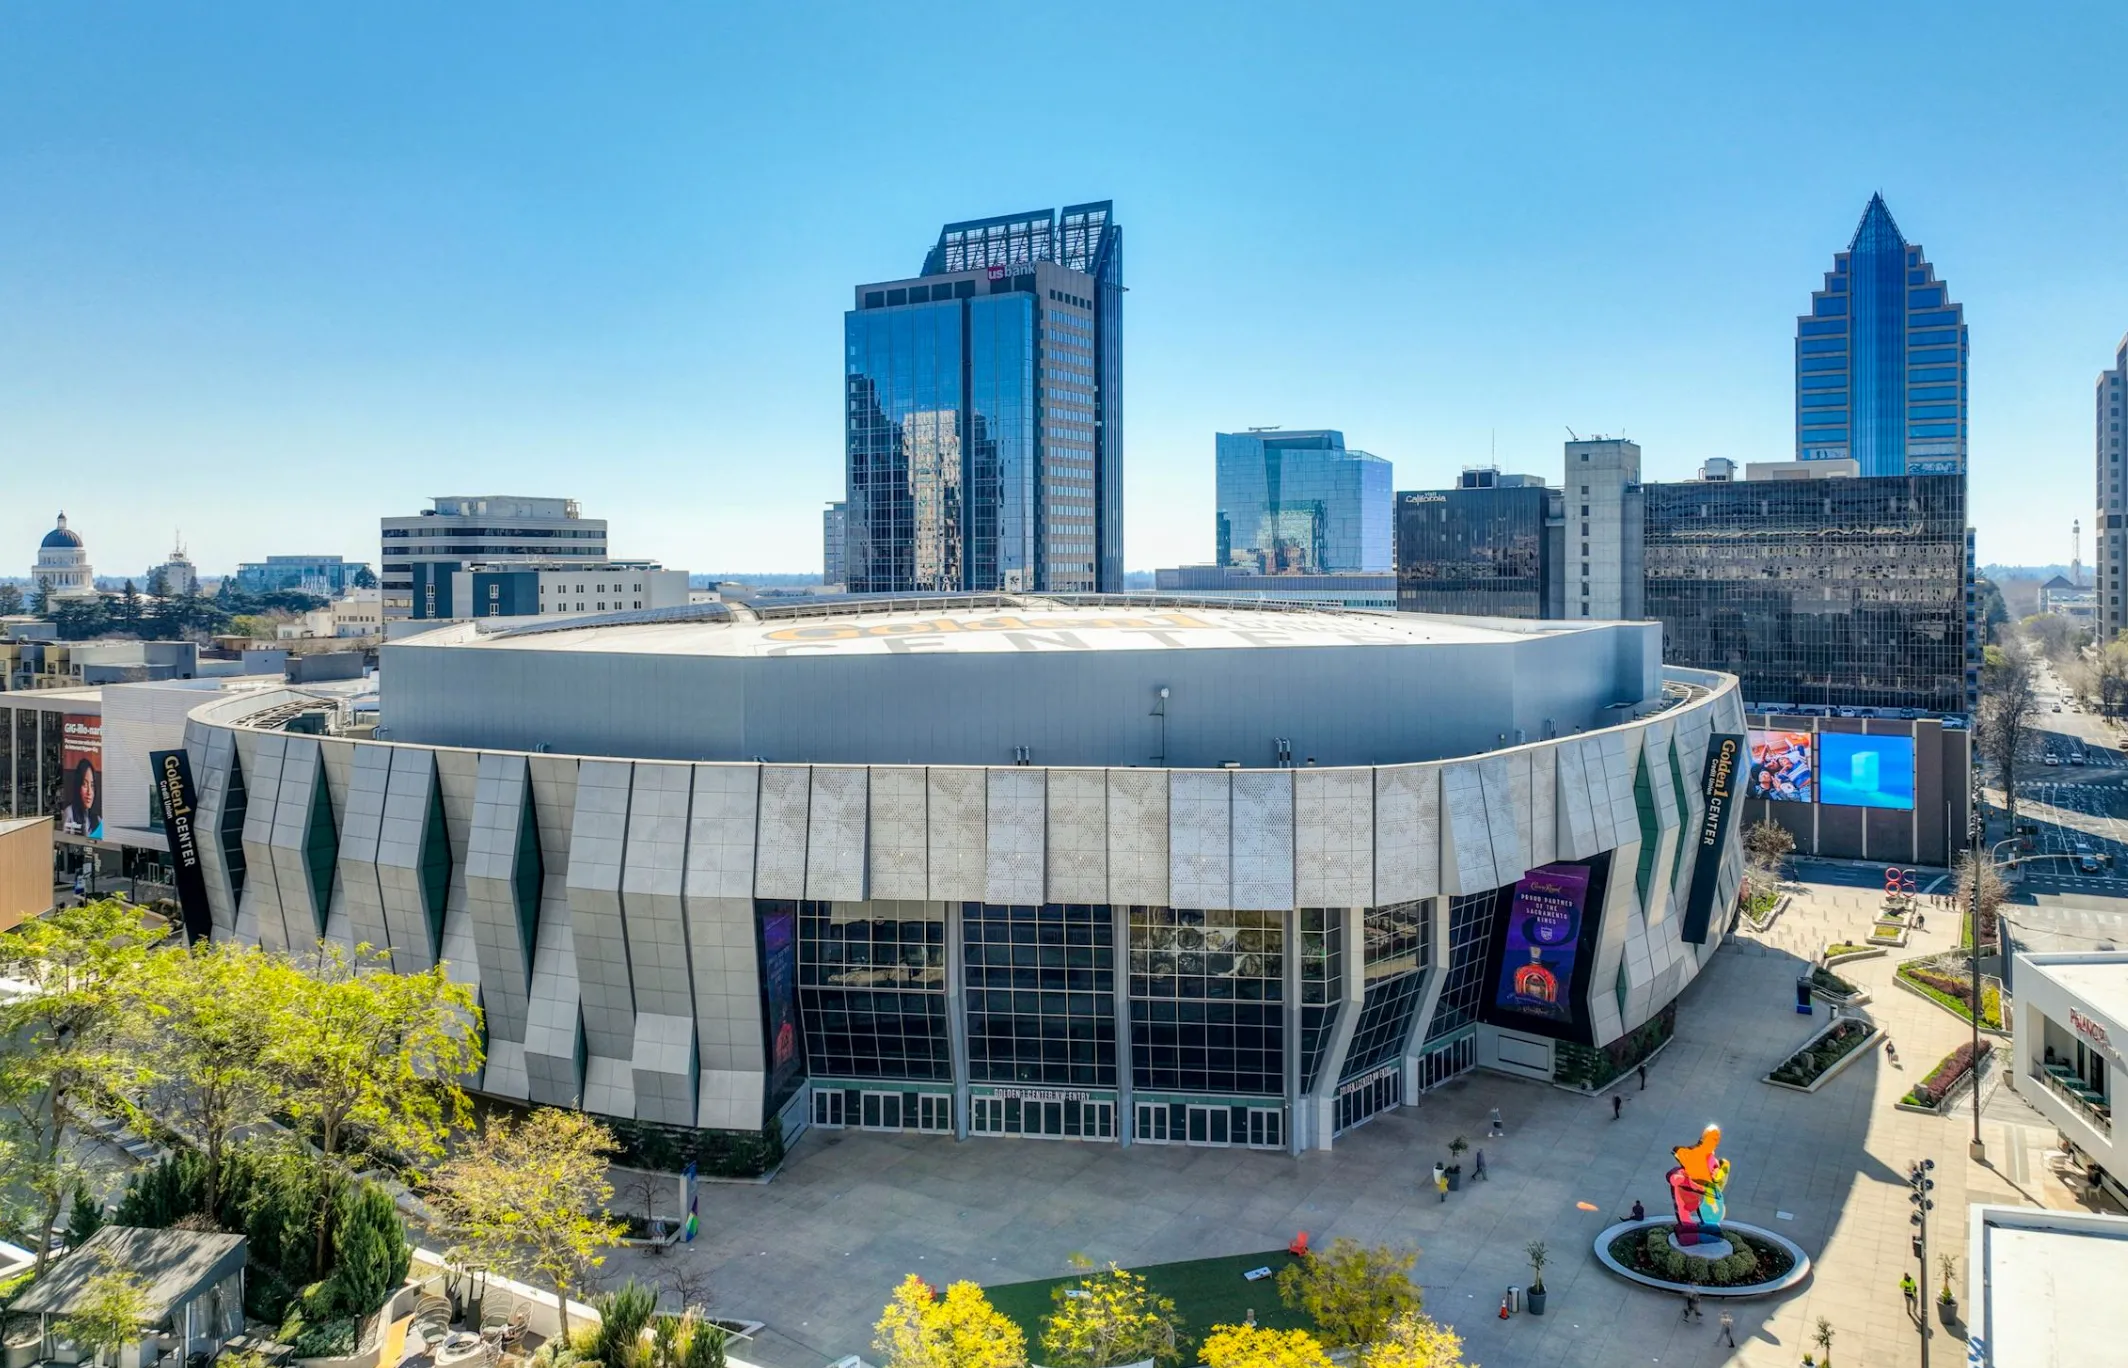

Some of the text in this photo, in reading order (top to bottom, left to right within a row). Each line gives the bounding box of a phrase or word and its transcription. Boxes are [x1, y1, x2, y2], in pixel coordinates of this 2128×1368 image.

[1004, 262, 1036, 278] bank
[1709, 758, 1719, 777] Credit
[160, 780, 173, 819] Credit Union
[1704, 797, 1722, 845] CENTER
[175, 817, 196, 867] CENTER
[1521, 893, 1573, 907] PROUD PARTNER
[1526, 907, 1568, 920] SACRAMENTO
[1537, 916, 1557, 925] KINGS
[994, 1088, 1020, 1099] GOLDEN
[1027, 1090, 1053, 1100] CENTER
[1056, 1090, 1067, 1100] NW
[1069, 1091, 1091, 1101] ENTRY
